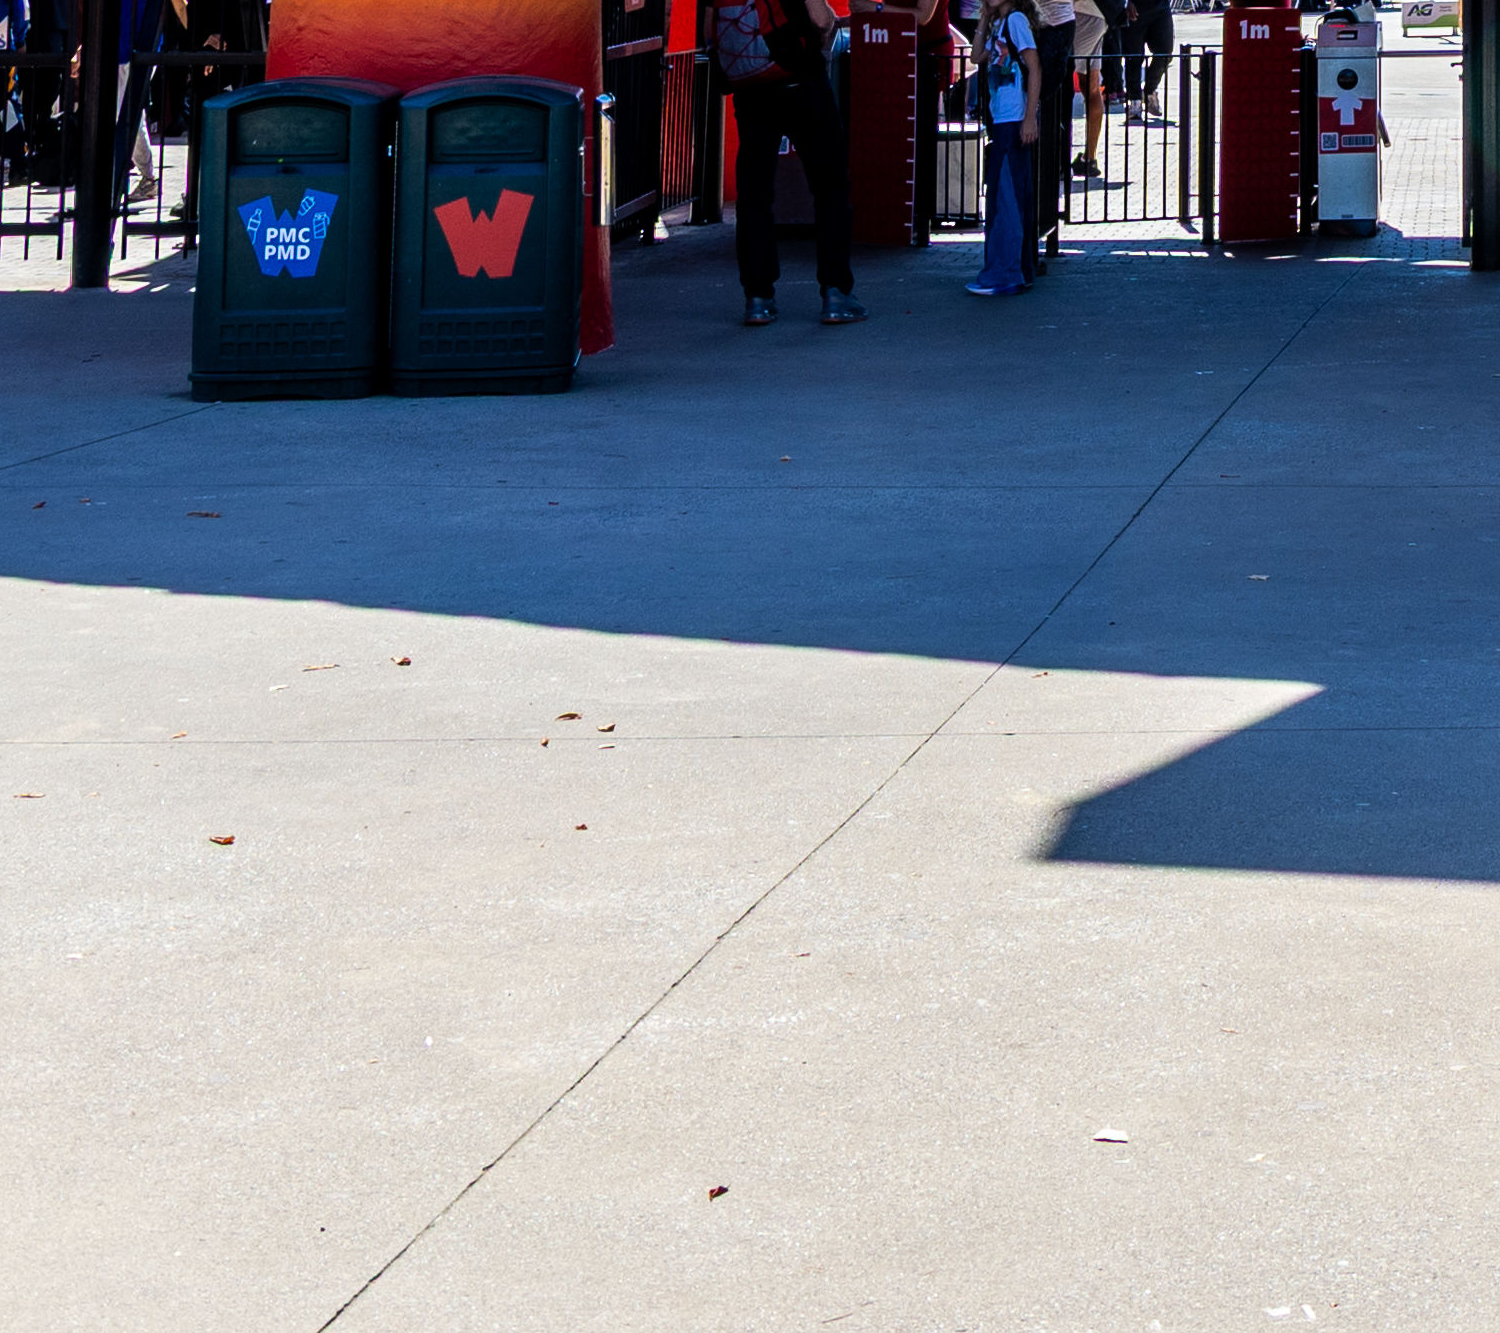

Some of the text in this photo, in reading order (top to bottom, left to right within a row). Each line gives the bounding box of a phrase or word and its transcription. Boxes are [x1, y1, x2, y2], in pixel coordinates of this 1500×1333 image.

[1407, 3, 1434, 17] AG
[863, 23, 889, 43] 1m
[1239, 19, 1270, 39] 1m
[265, 227, 311, 244] PMC
[433, 188, 535, 279] W
[263, 244, 312, 261] PMD
